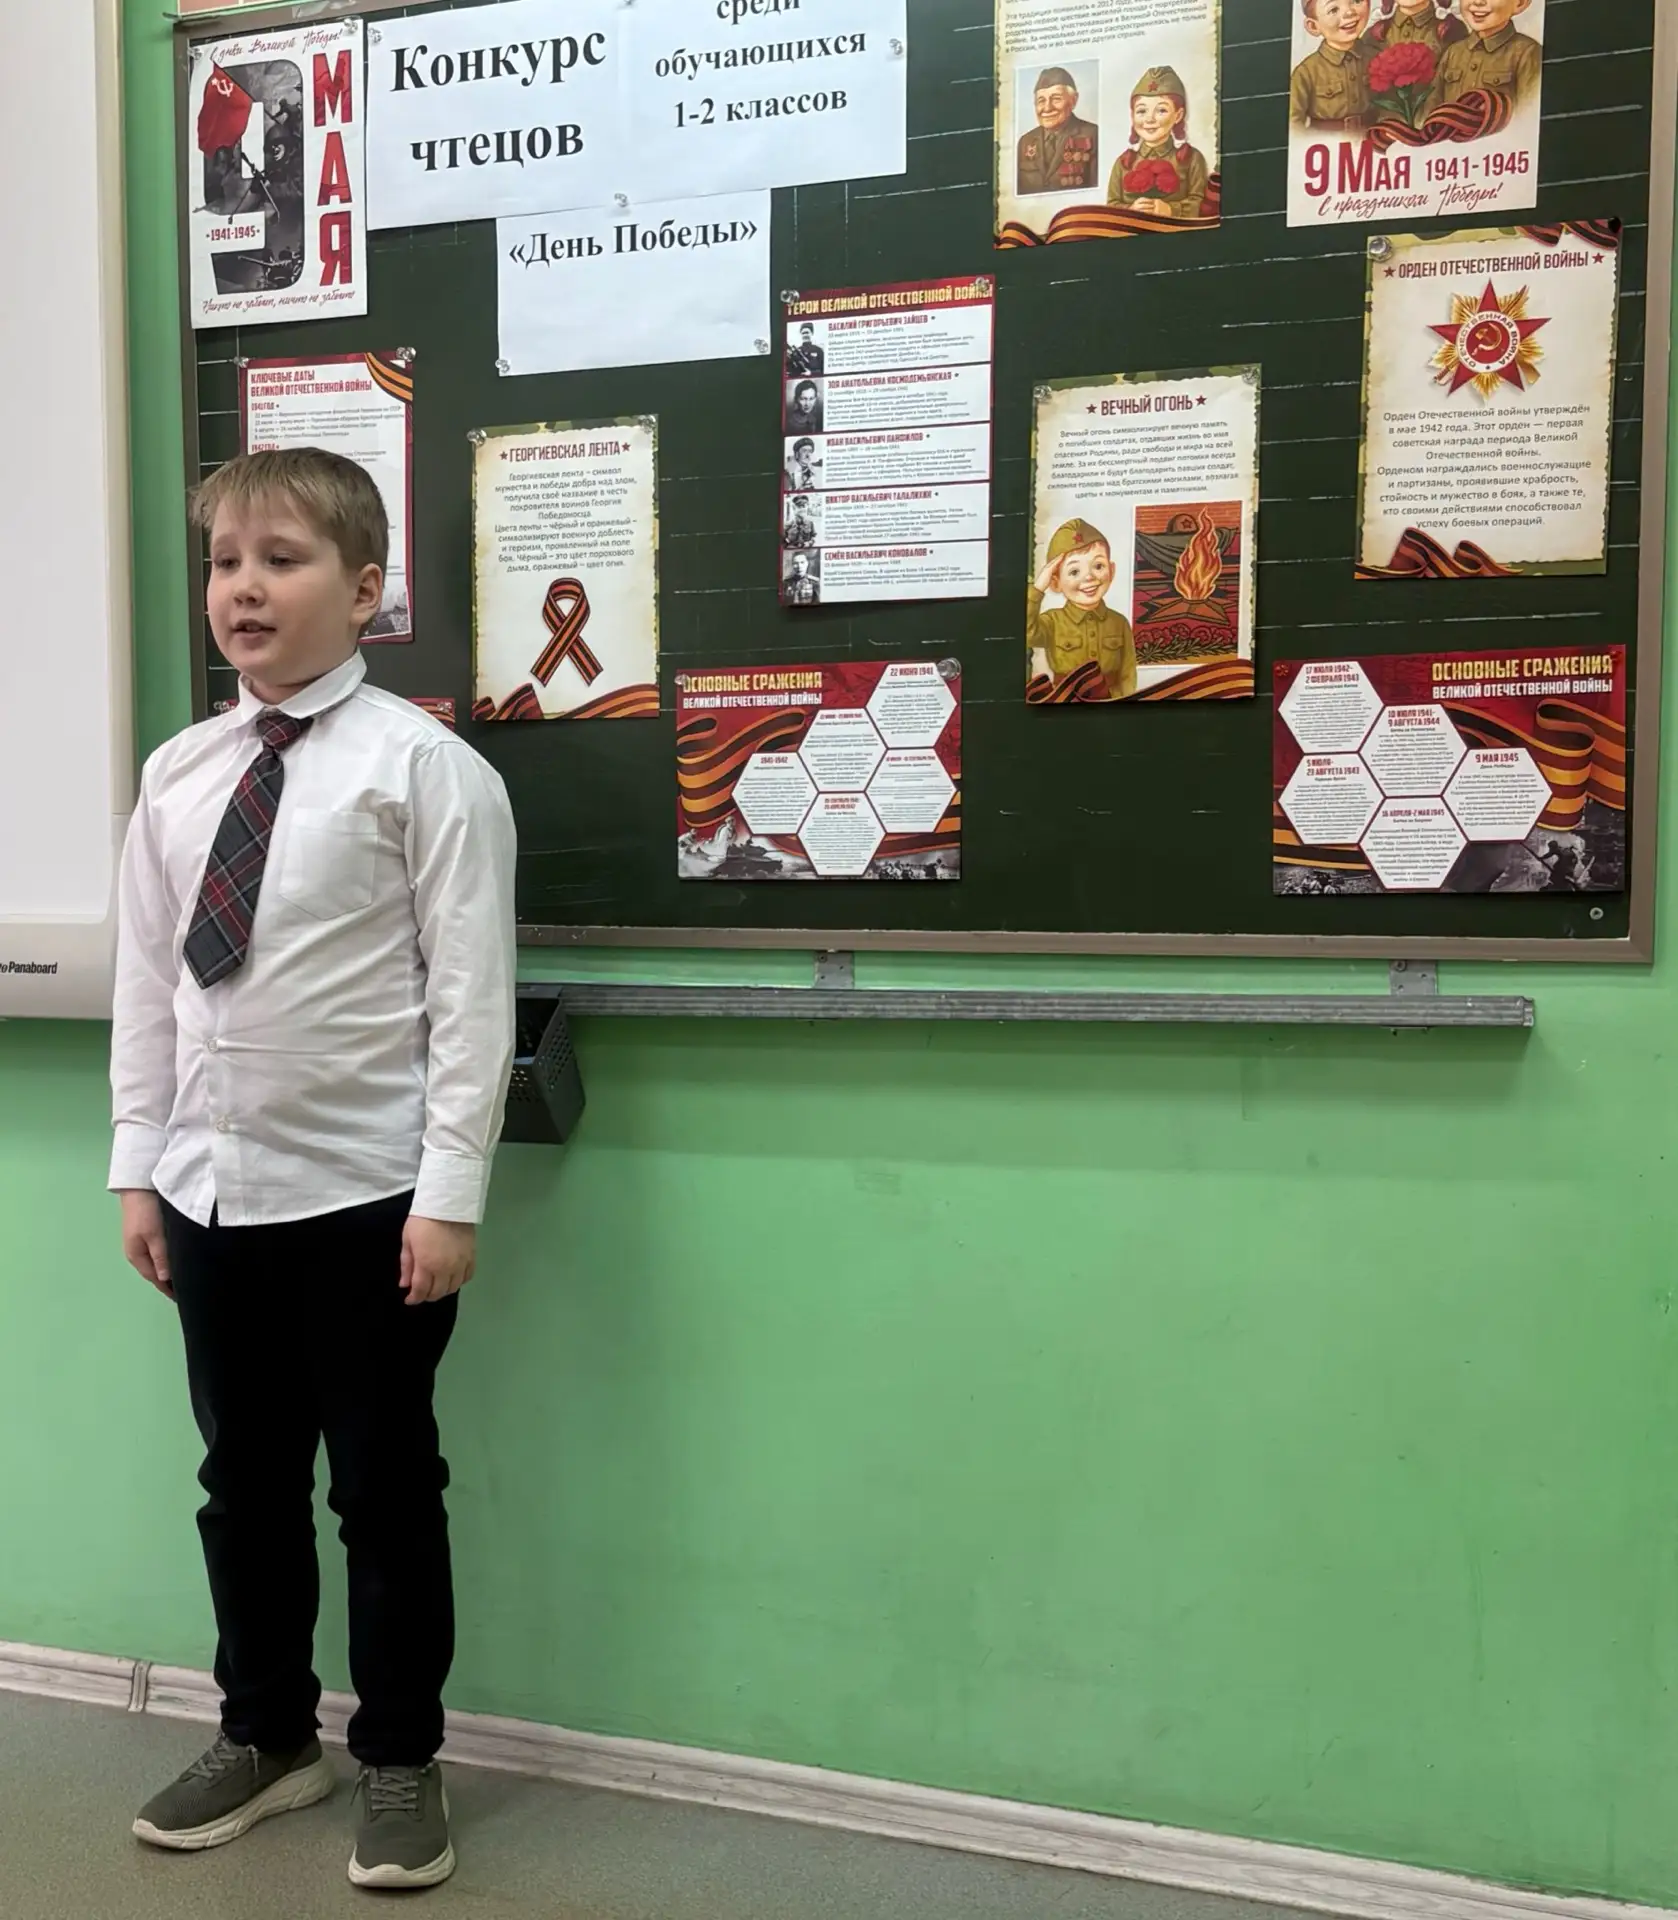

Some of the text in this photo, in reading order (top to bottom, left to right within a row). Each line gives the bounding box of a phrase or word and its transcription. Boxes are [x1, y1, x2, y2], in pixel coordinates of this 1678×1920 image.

[717, 0, 800, 25] среди
[248, 36, 298, 54] Великой
[302, 28, 344, 54] Победы!
[389, 28, 607, 92] Конкурс
[655, 32, 867, 80] обучающихся
[673, 90, 848, 128] 1-2 классов
[410, 121, 584, 172] чтецов
[312, 49, 353, 287] МАЯ
[1304, 144, 1330, 196] 9
[1425, 151, 1529, 182] 1941-1945
[1318, 182, 1504, 220] С праздником Победы!
[508, 218, 758, 268] «День Победы»
[1398, 250, 1588, 278] ОРДЕН ОТЕЧЕСТВЕННОЙ ВОЙНЫ
[202, 289, 355, 314] Никто не забыт, ничто не забыто
[869, 286, 952, 308] ОТЕЧЕСТВЕННОЙ
[250, 370, 314, 384] КЛЮЧЕВЫЕ ДАТЫ
[250, 378, 371, 397] ВЕЛИКОЙ ОТЕЧЕСТВЕННОЙ ВОЙНЫ
[1101, 395, 1192, 416] ВЕЧНЫЙ ОГОНЬ
[1383, 404, 1590, 423] Орден Отечественной войны утверждён
[1420, 424, 1442, 433] 1942
[1445, 425, 1470, 434] года.
[1473, 422, 1495, 431] Этот
[1498, 423, 1530, 433] орден
[1546, 421, 1583, 431] первая
[1392, 432, 1577, 448] советская награда периода Великой
[509, 441, 620, 462] ГЕОРГИЕВСКАЯ ЛЕНТА
[1425, 448, 1541, 459] Отечественной войны.
[1376, 462, 1591, 477] Орденом награждались военнослужащие
[1396, 480, 1453, 490] партизаны,
[1456, 478, 1520, 488] проявившие
[1523, 475, 1578, 487] храбрость,
[1379, 492, 1428, 502] стойкость
[1439, 493, 1489, 503] мужество
[1500, 490, 1526, 501] боях,
[1538, 490, 1569, 498] также
[1572, 490, 1585, 499] те,
[1441, 504, 1502, 516] действиями
[1504, 502, 1581, 512] способствовал
[1416, 516, 1545, 530] успеху боевых операций.
[1432, 656, 1612, 681] ОСНОВНЫЕ СРАЖЕНИЯ
[752, 672, 822, 690] СРАЖЕНИЯ
[1432, 678, 1612, 699] ВЕЛИКОЙ ОТЕЧЕСТВЕННОЙ ВОЙНЫ
[683, 691, 822, 709] ВЕЛИКОЙ ОТЕЧЕСТВЕННОЙ ВОЙНЫ
[8, 961, 58, 974] Panaboard
